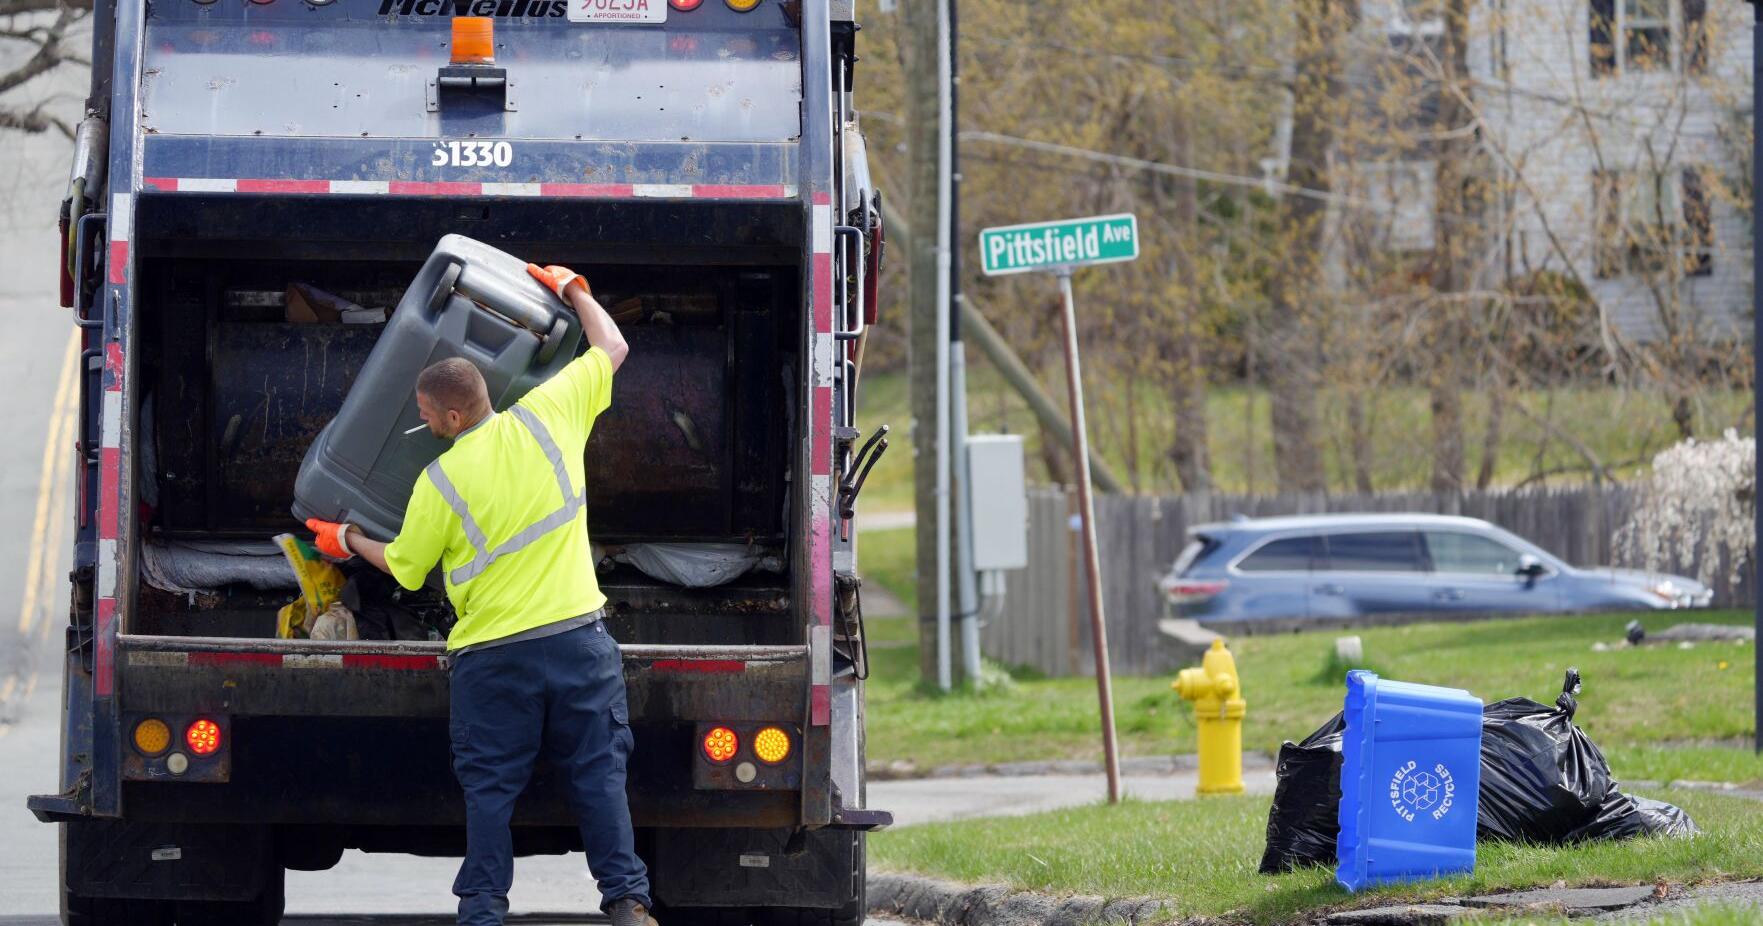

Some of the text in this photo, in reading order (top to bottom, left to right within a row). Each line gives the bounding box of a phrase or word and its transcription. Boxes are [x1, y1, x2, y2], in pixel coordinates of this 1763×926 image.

[432, 141, 513, 167] S1330
[989, 223, 1131, 268] Pittsfield Ave
[1390, 760, 1417, 822] PITTSFIELD
[1432, 763, 1455, 820] RECYCLES
